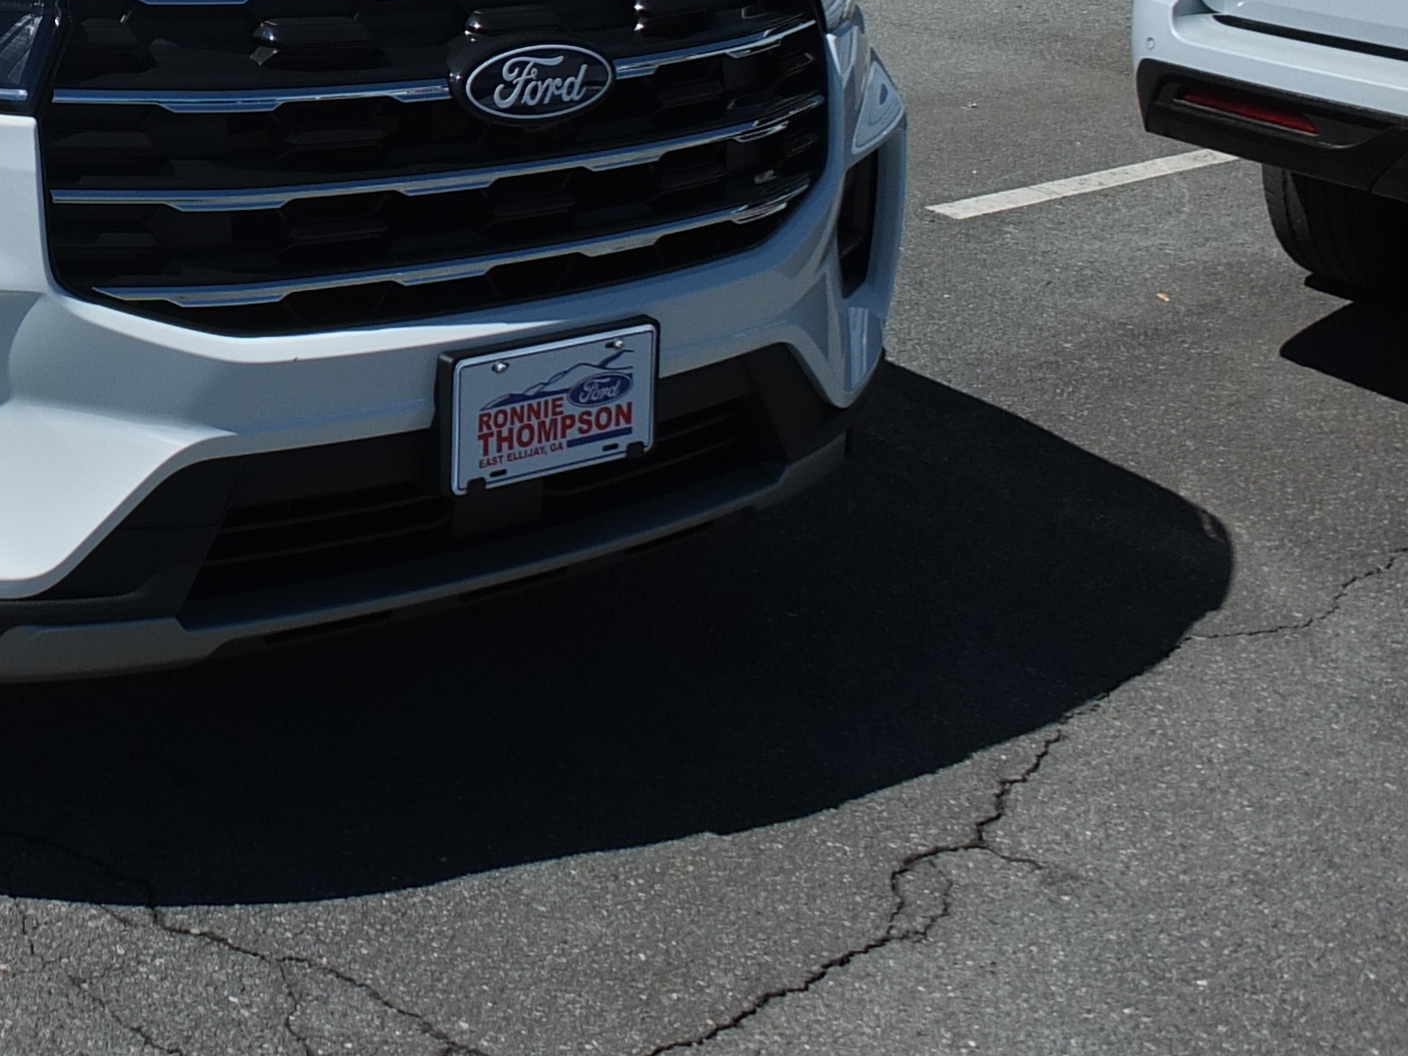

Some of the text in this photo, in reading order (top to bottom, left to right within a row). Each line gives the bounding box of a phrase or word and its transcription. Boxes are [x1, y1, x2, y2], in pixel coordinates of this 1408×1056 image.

[493, 54, 588, 110] Ford
[579, 378, 620, 403] Ford
[478, 397, 564, 433] RONNIE
[478, 402, 633, 456] THOMPSON
[478, 441, 564, 469] EAST ELLIJAY, GA
